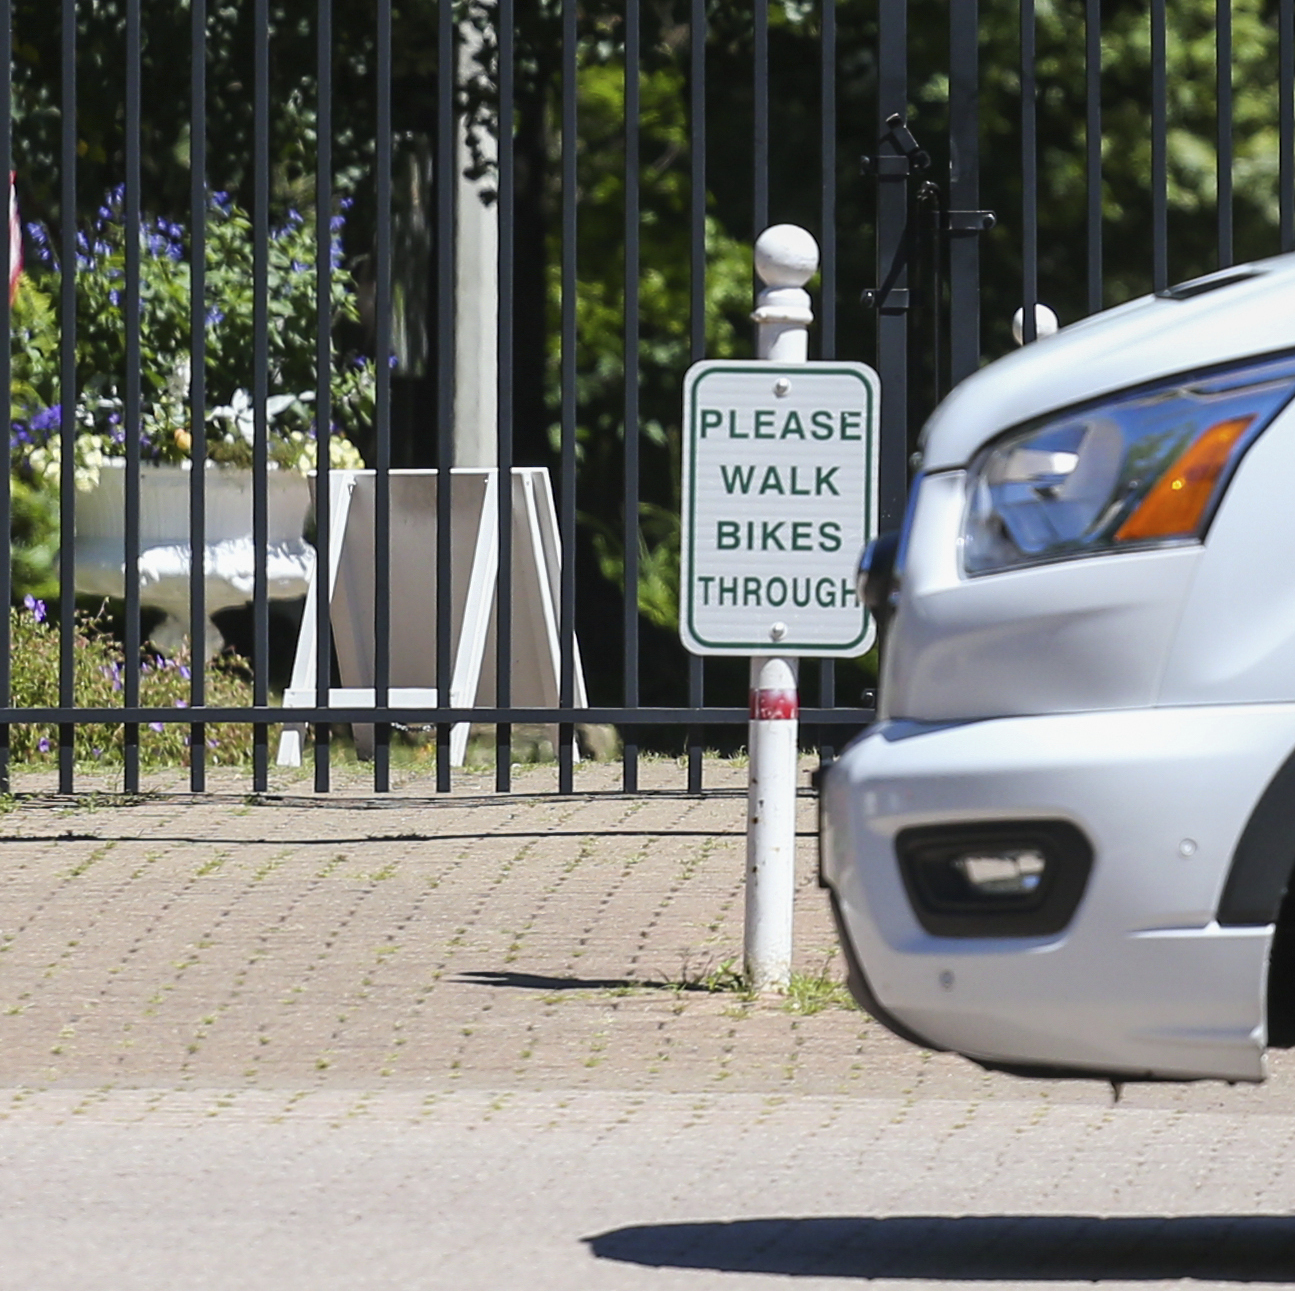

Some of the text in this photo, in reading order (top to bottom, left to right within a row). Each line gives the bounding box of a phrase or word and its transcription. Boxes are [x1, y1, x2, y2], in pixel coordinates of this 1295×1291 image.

[700, 409, 862, 441] PLEASE
[720, 465, 840, 496] WALK
[717, 520, 842, 552] BIKES
[697, 576, 860, 608] THROUGH
